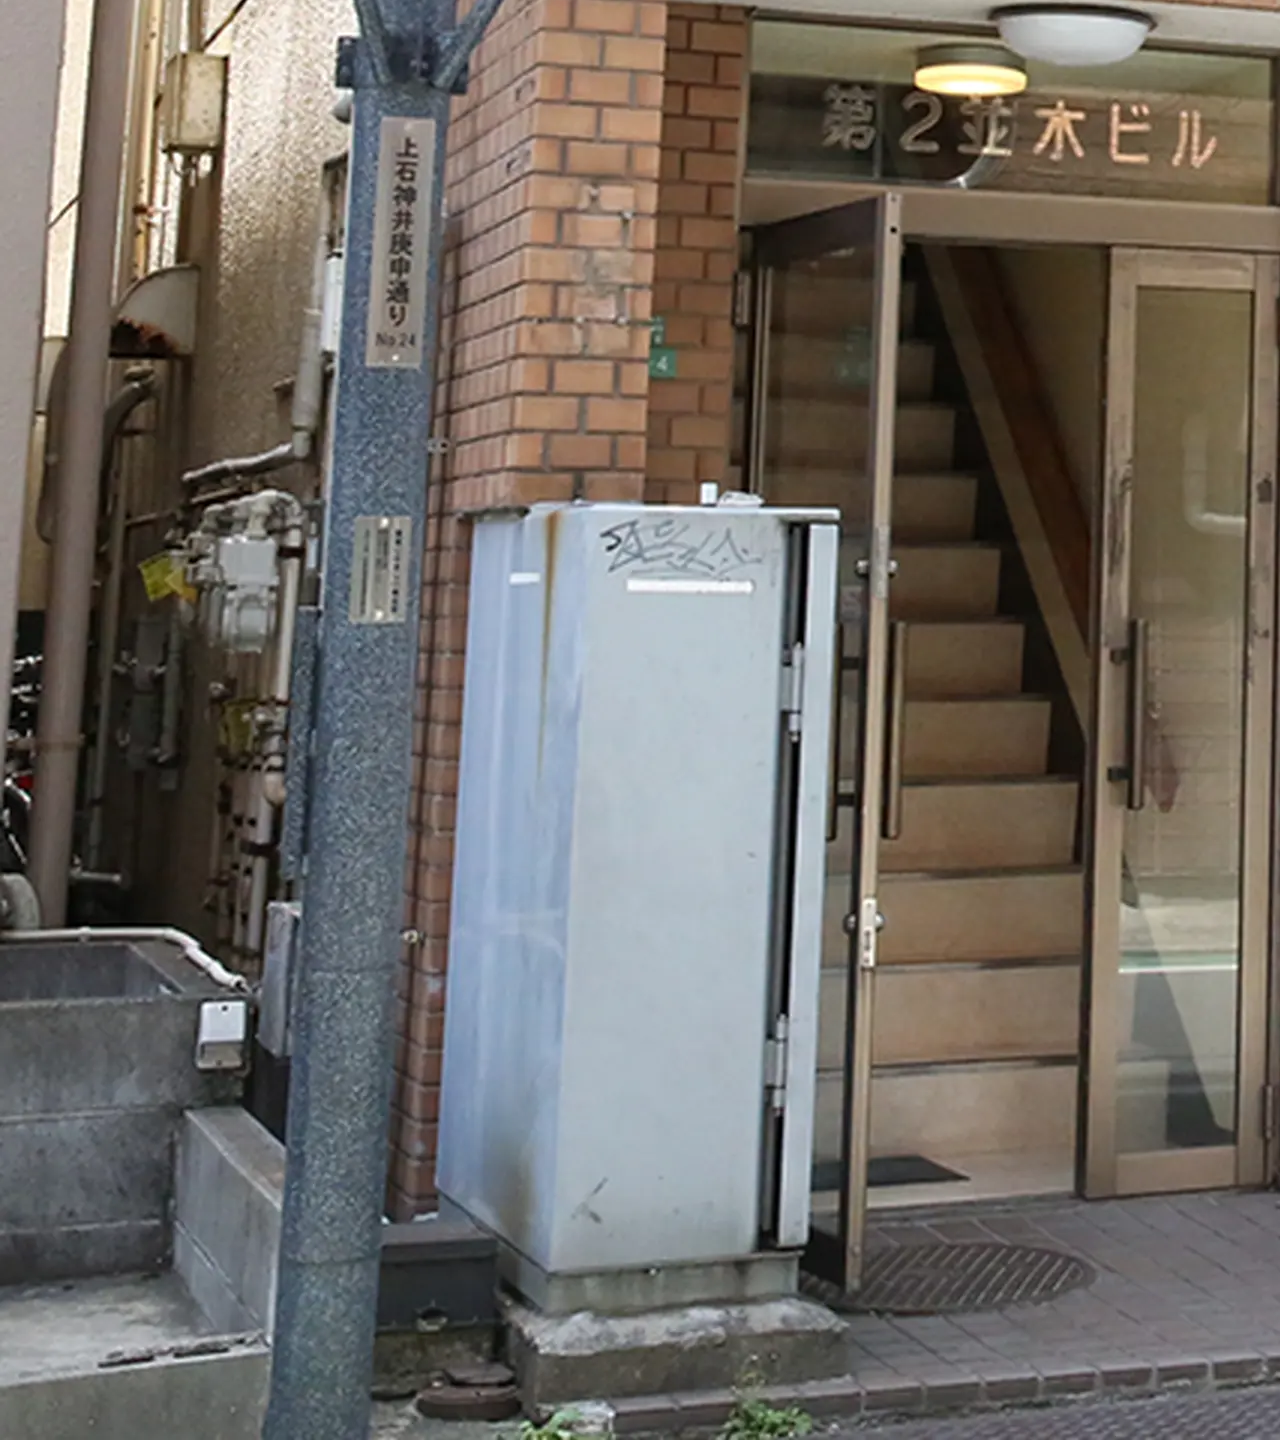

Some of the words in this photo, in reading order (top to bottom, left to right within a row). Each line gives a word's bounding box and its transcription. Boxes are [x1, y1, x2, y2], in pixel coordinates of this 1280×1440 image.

[386, 136, 420, 328] 上石神井庚申通り
